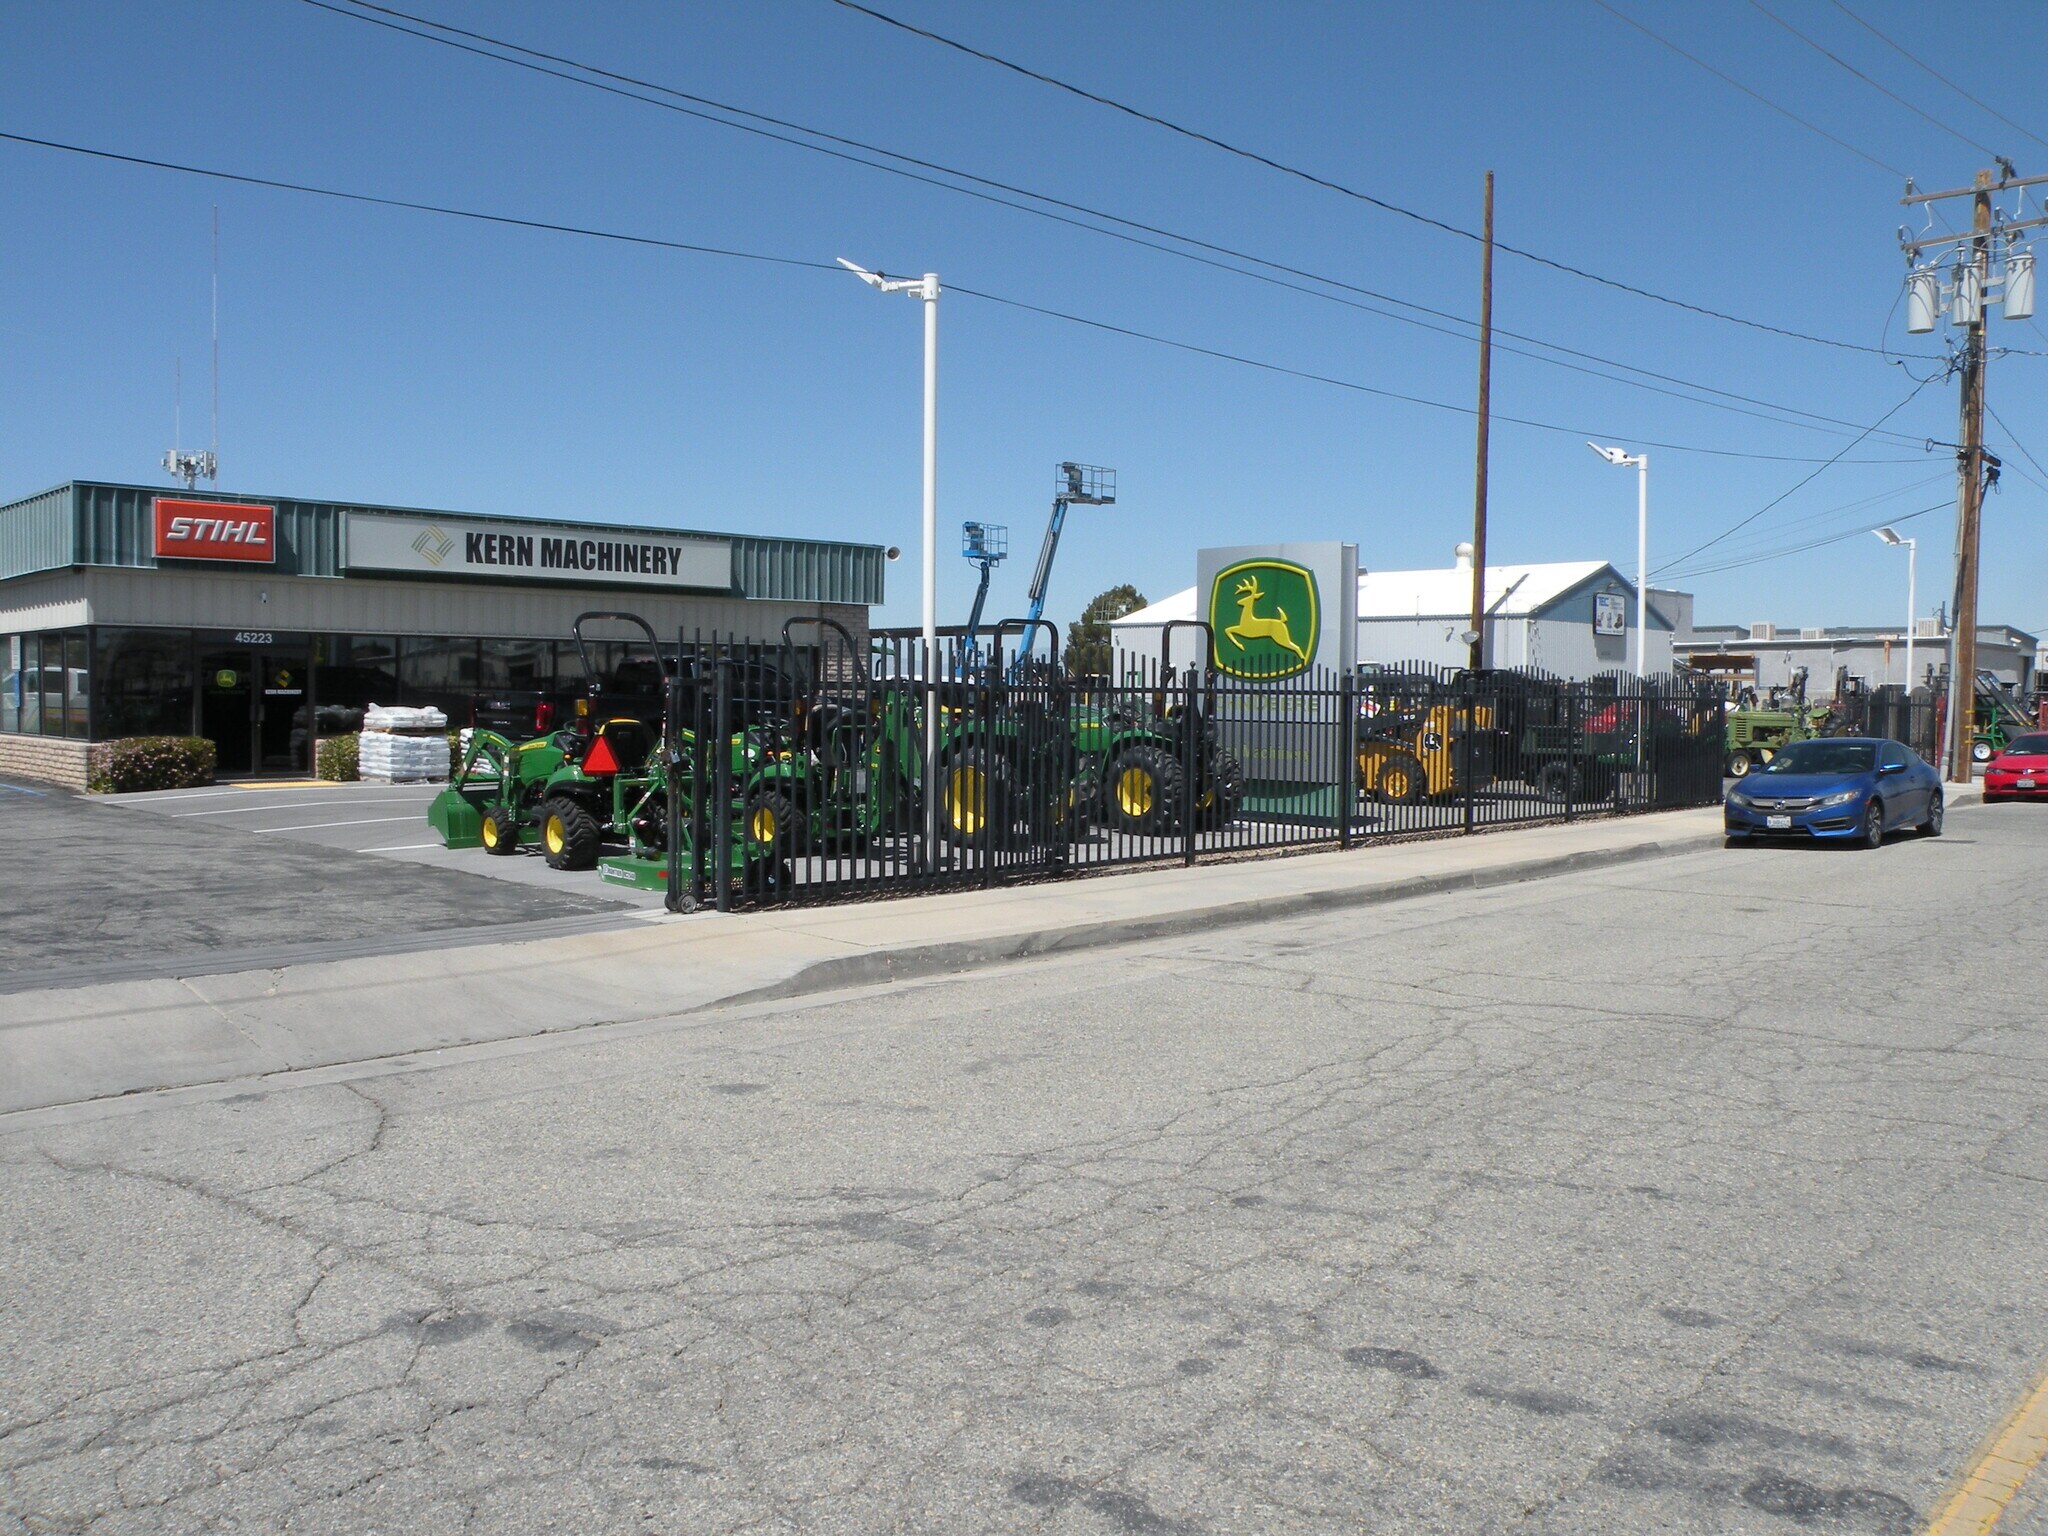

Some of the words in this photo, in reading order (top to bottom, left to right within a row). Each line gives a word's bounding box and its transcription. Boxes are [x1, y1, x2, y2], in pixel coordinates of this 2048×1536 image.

[167, 516, 267, 544] STIHL
[466, 532, 533, 566] KERN
[541, 537, 682, 575] MACHINERY
[235, 632, 273, 644] 45223
